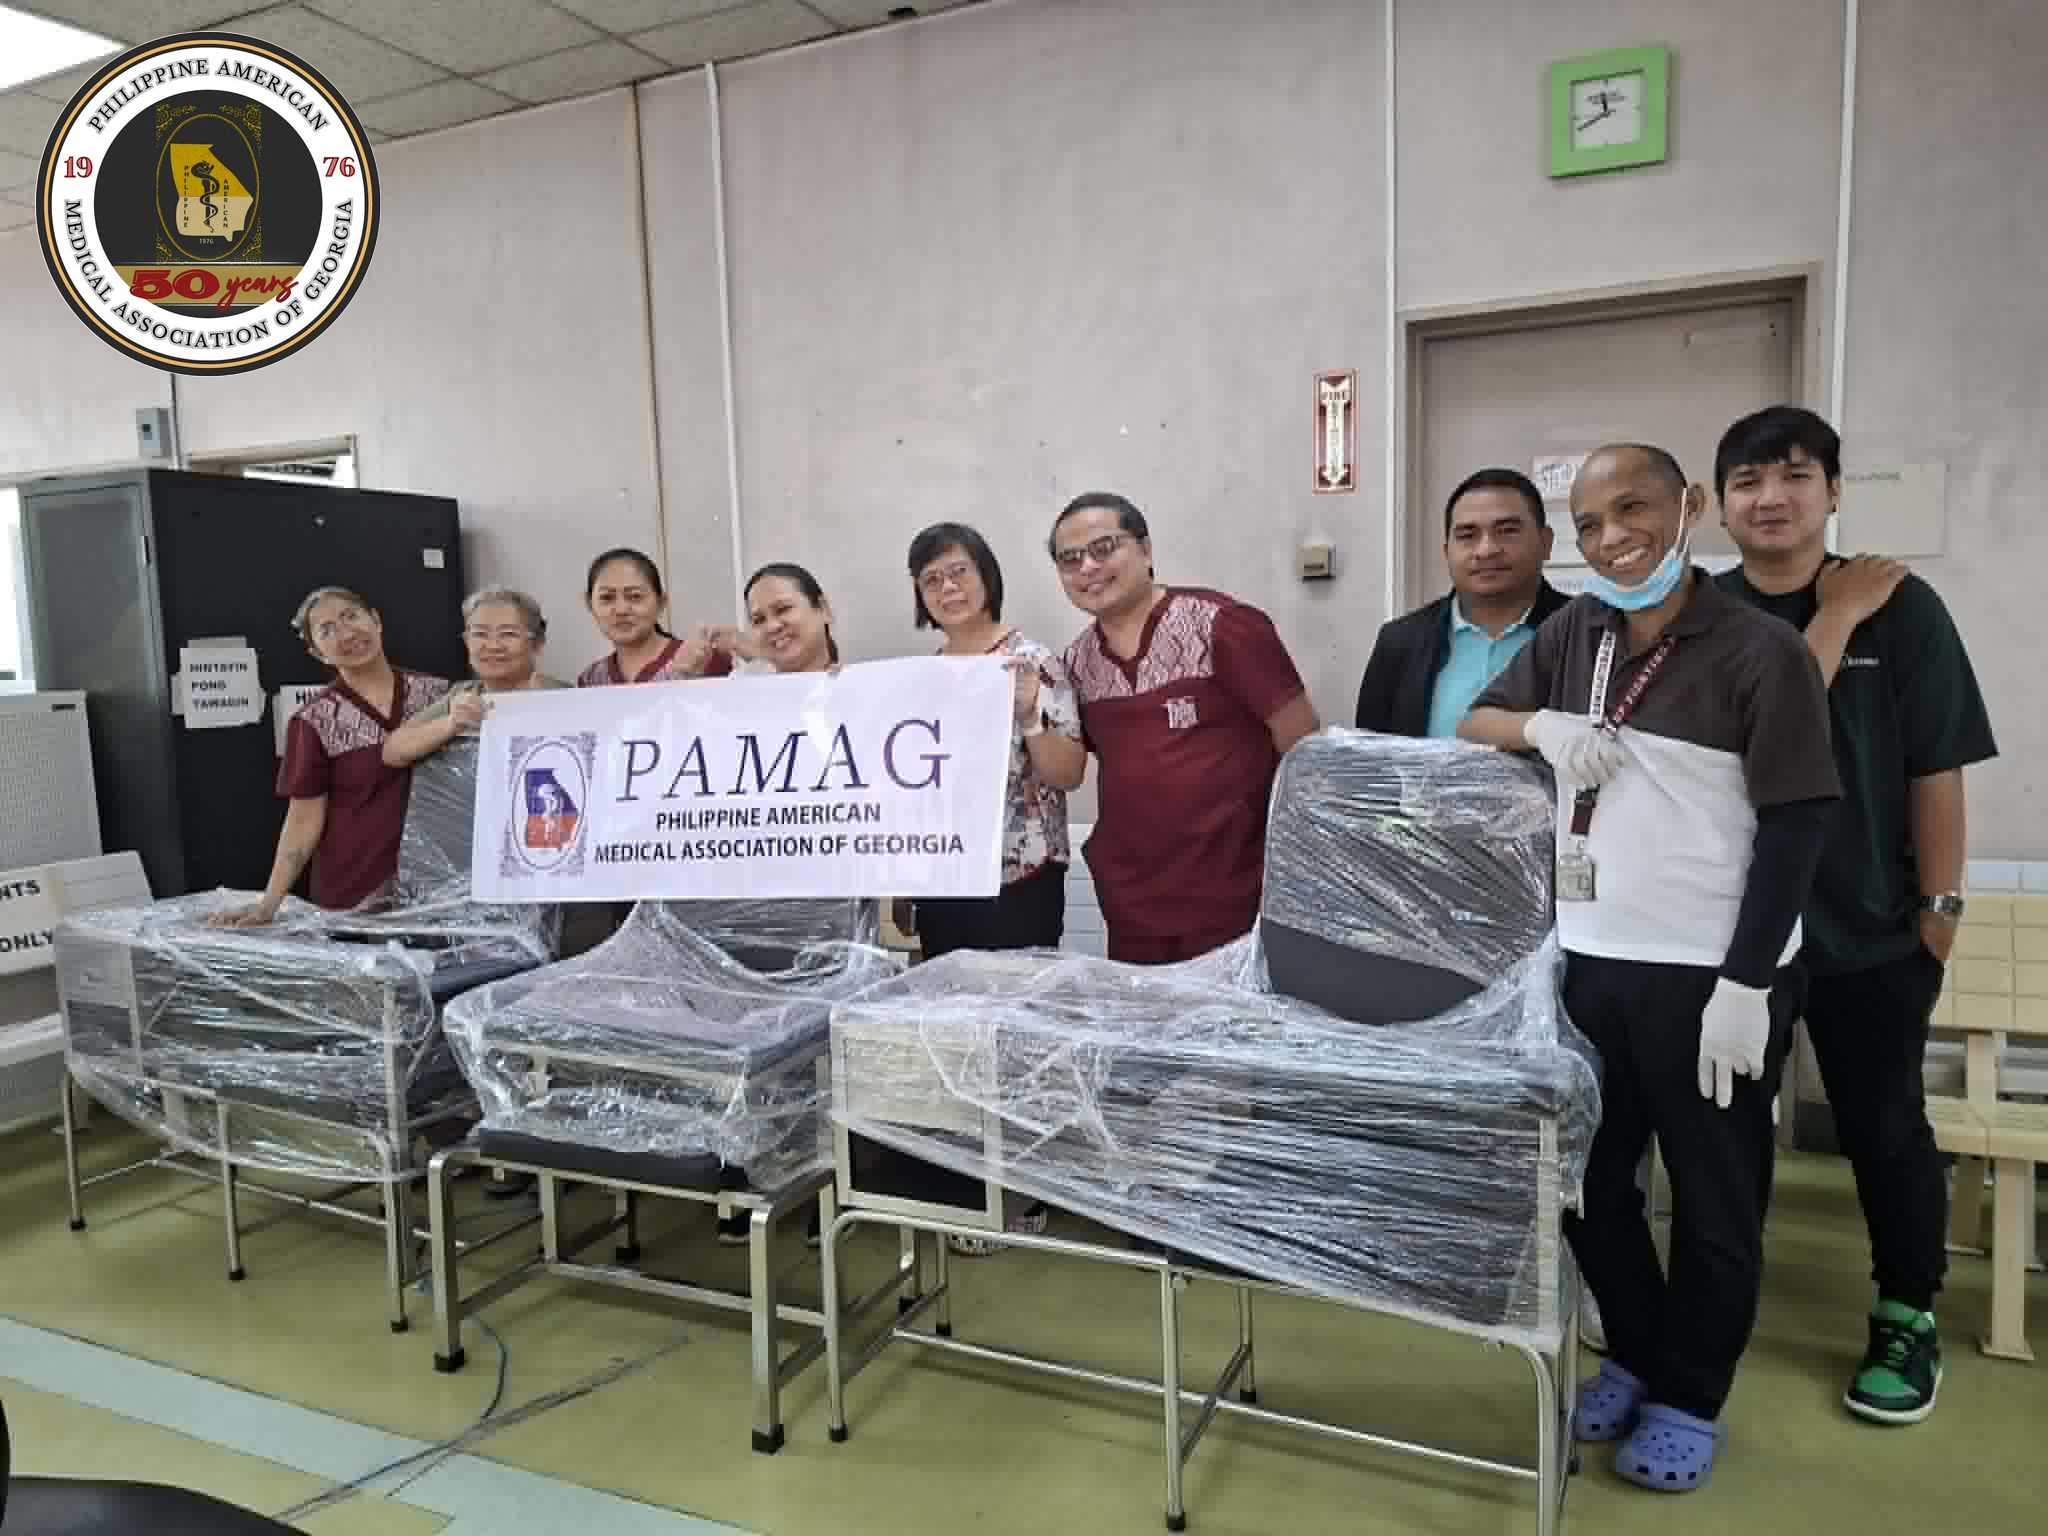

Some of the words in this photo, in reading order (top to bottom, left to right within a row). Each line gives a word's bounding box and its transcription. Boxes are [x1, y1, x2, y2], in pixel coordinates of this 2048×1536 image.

[616, 717, 952, 802] PAMAG
[655, 806, 762, 832] PHILIPPINE
[767, 803, 882, 825] AMERICAN
[595, 841, 677, 864] MEDICAL
[681, 836, 813, 861] ASSOCIATION
[819, 835, 849, 856] OF
[853, 834, 965, 856] GEORGIA
[0, 931, 53, 953] ONLY
